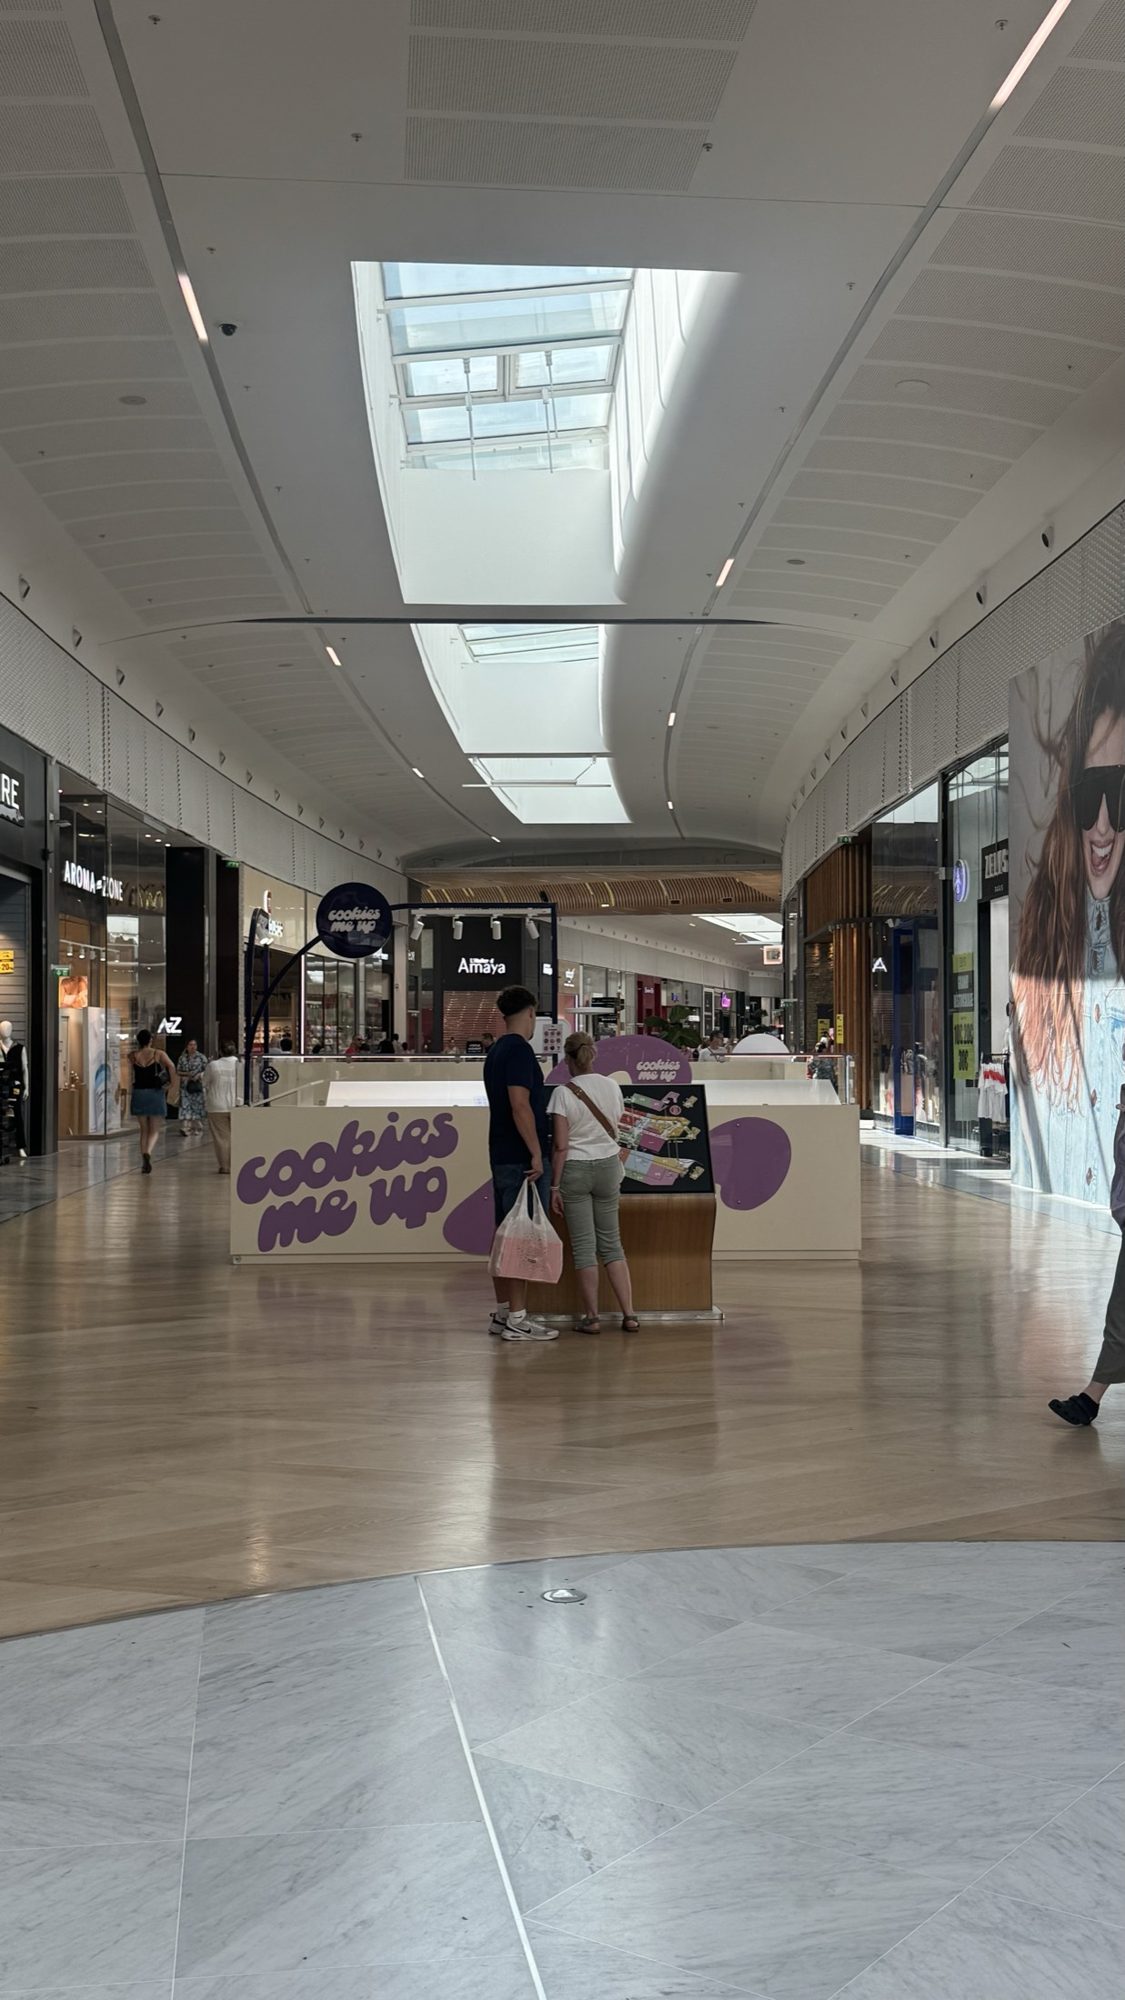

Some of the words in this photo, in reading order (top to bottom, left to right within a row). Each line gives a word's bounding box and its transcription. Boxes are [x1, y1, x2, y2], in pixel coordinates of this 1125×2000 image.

[328, 906, 381, 921] cookies
[330, 921, 355, 932] me
[356, 920, 377, 934] up
[458, 957, 506, 975] Amaya
[871, 956, 888, 973] A
[636, 1058, 681, 1071] cookies
[638, 1070, 658, 1080] me
[660, 1070, 677, 1083] up
[237, 1111, 459, 1205] cookies
[257, 1189, 358, 1253] me
[369, 1165, 448, 1230] up
